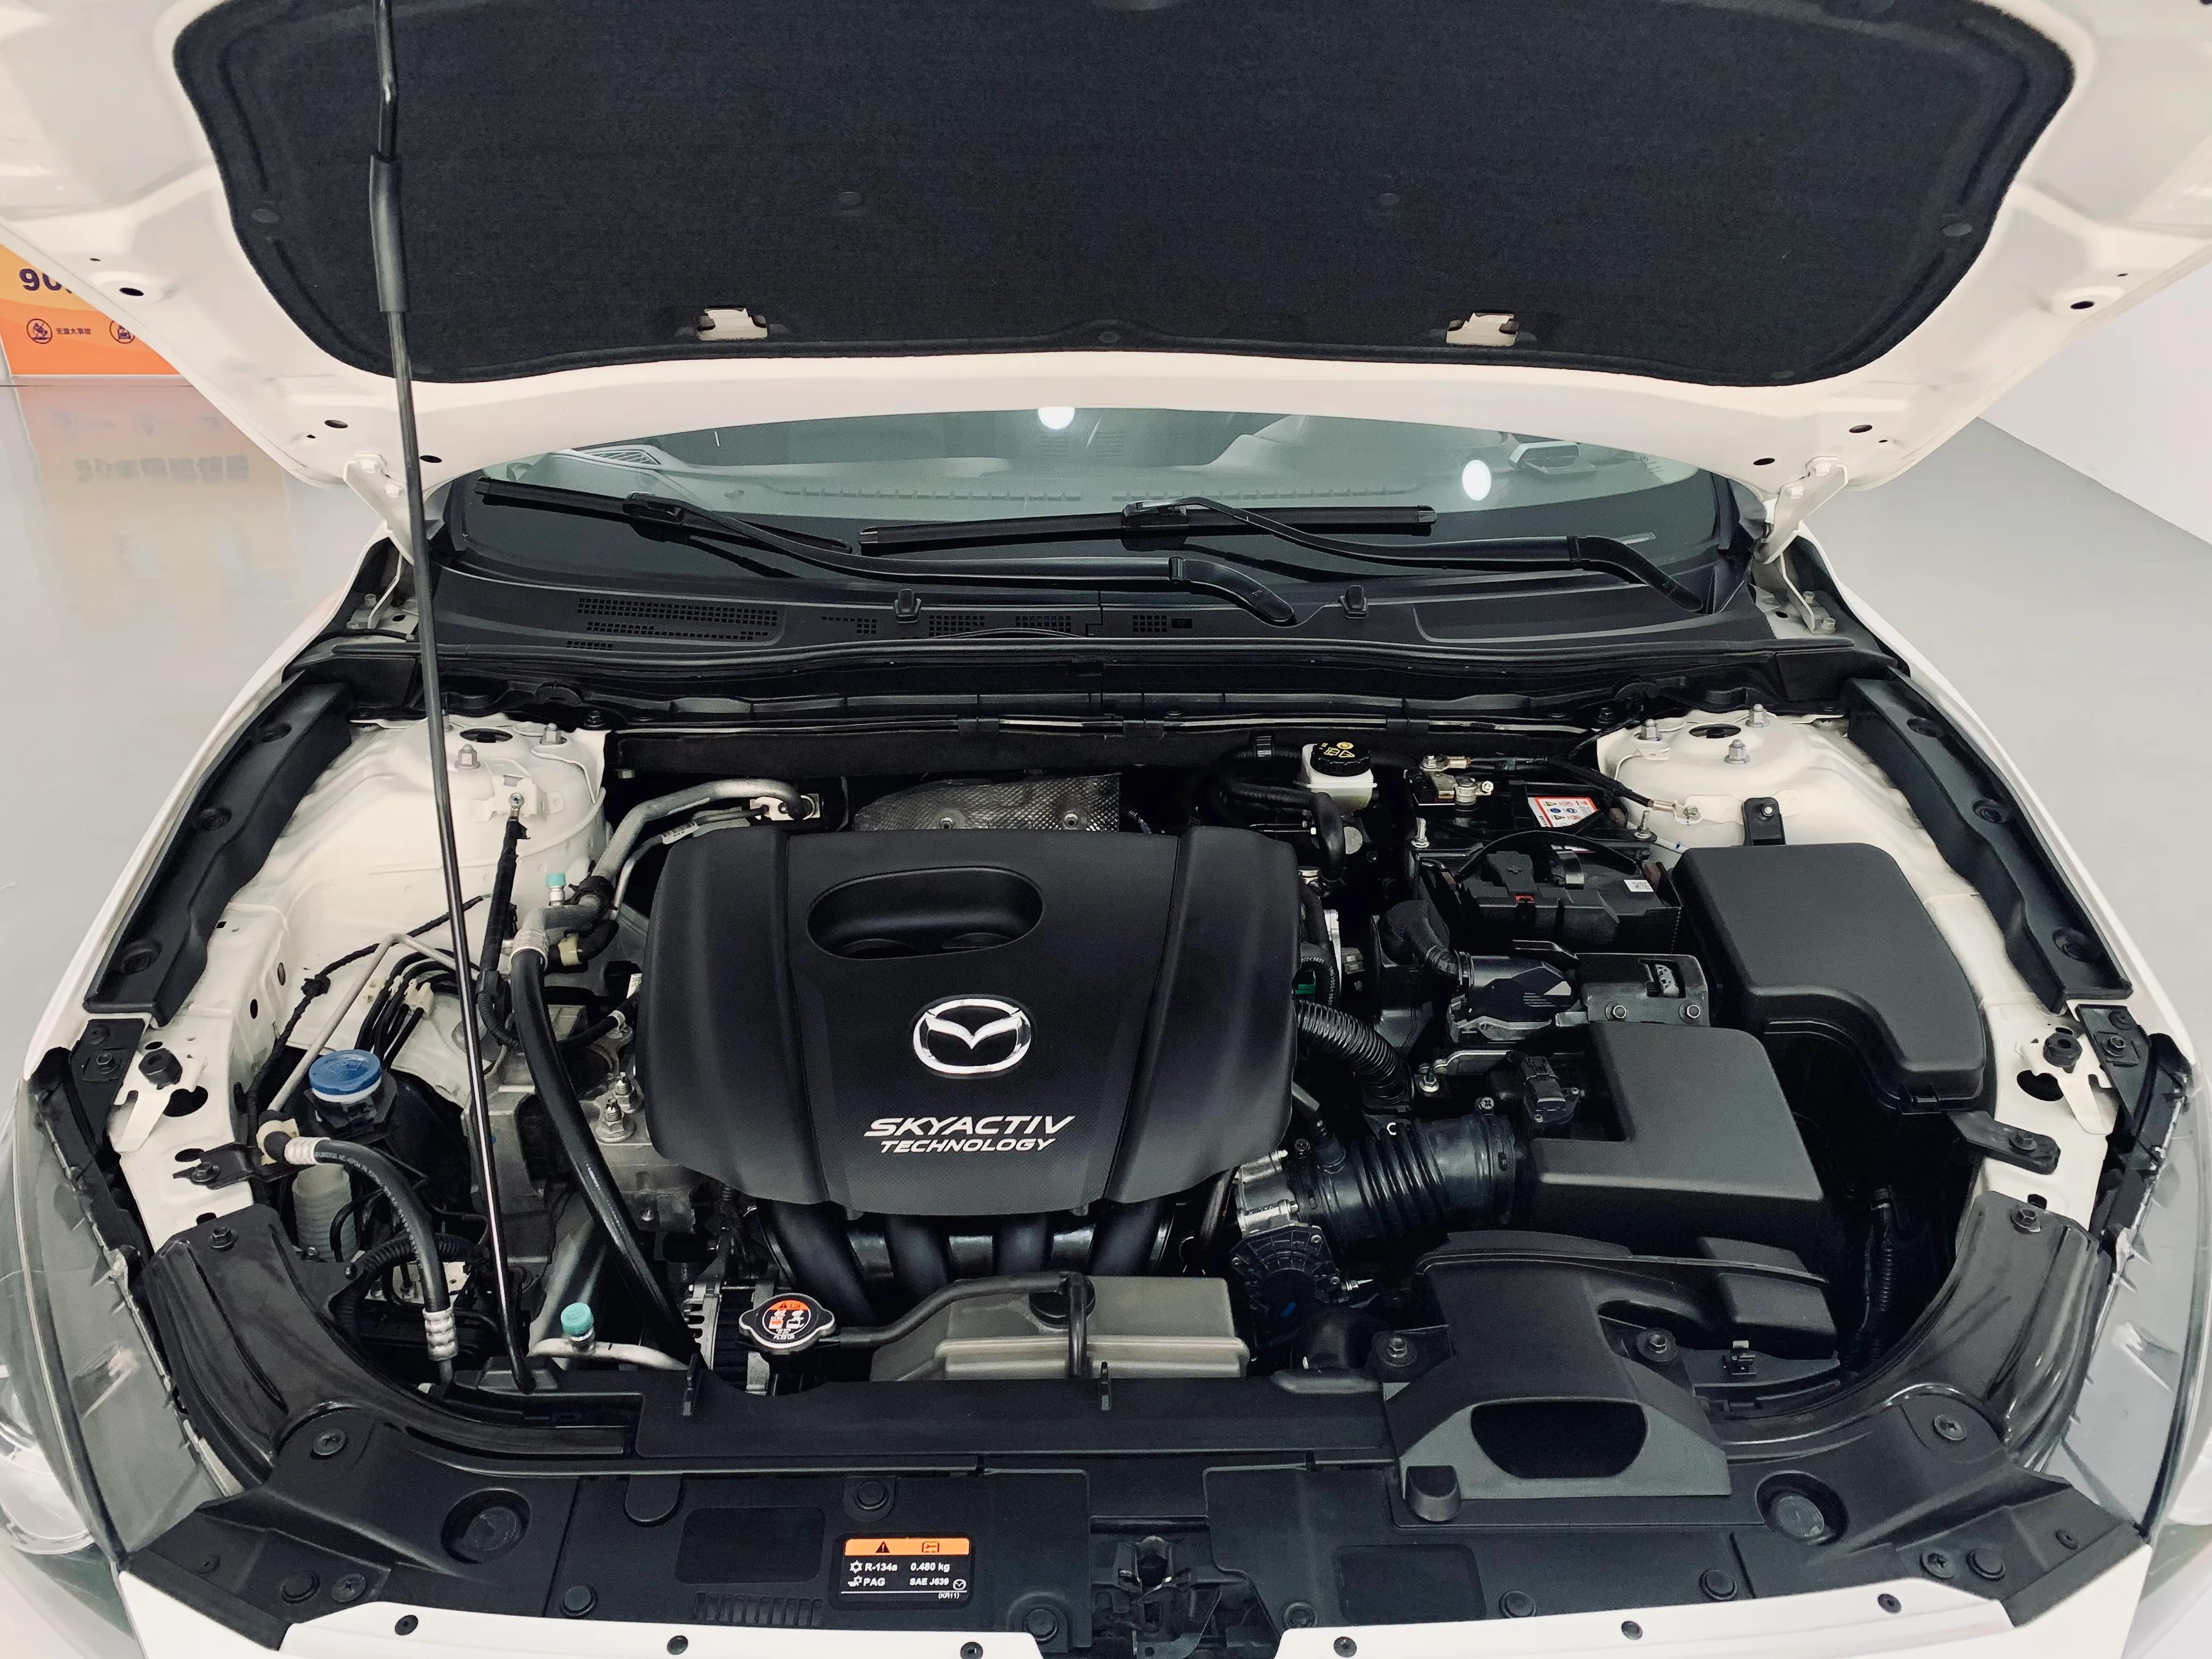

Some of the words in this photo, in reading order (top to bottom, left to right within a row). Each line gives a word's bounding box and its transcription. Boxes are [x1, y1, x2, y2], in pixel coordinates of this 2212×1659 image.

[19, 268, 72, 294] 90
[864, 1115, 1075, 1137] SKYACTIV
[881, 1138, 1056, 1154] TECHNOLOGY
[865, 1562, 898, 1572] R-134a
[938, 1562, 950, 1573] kg
[863, 1578, 885, 1587] PAG
[909, 1578, 928, 1586] SAE
